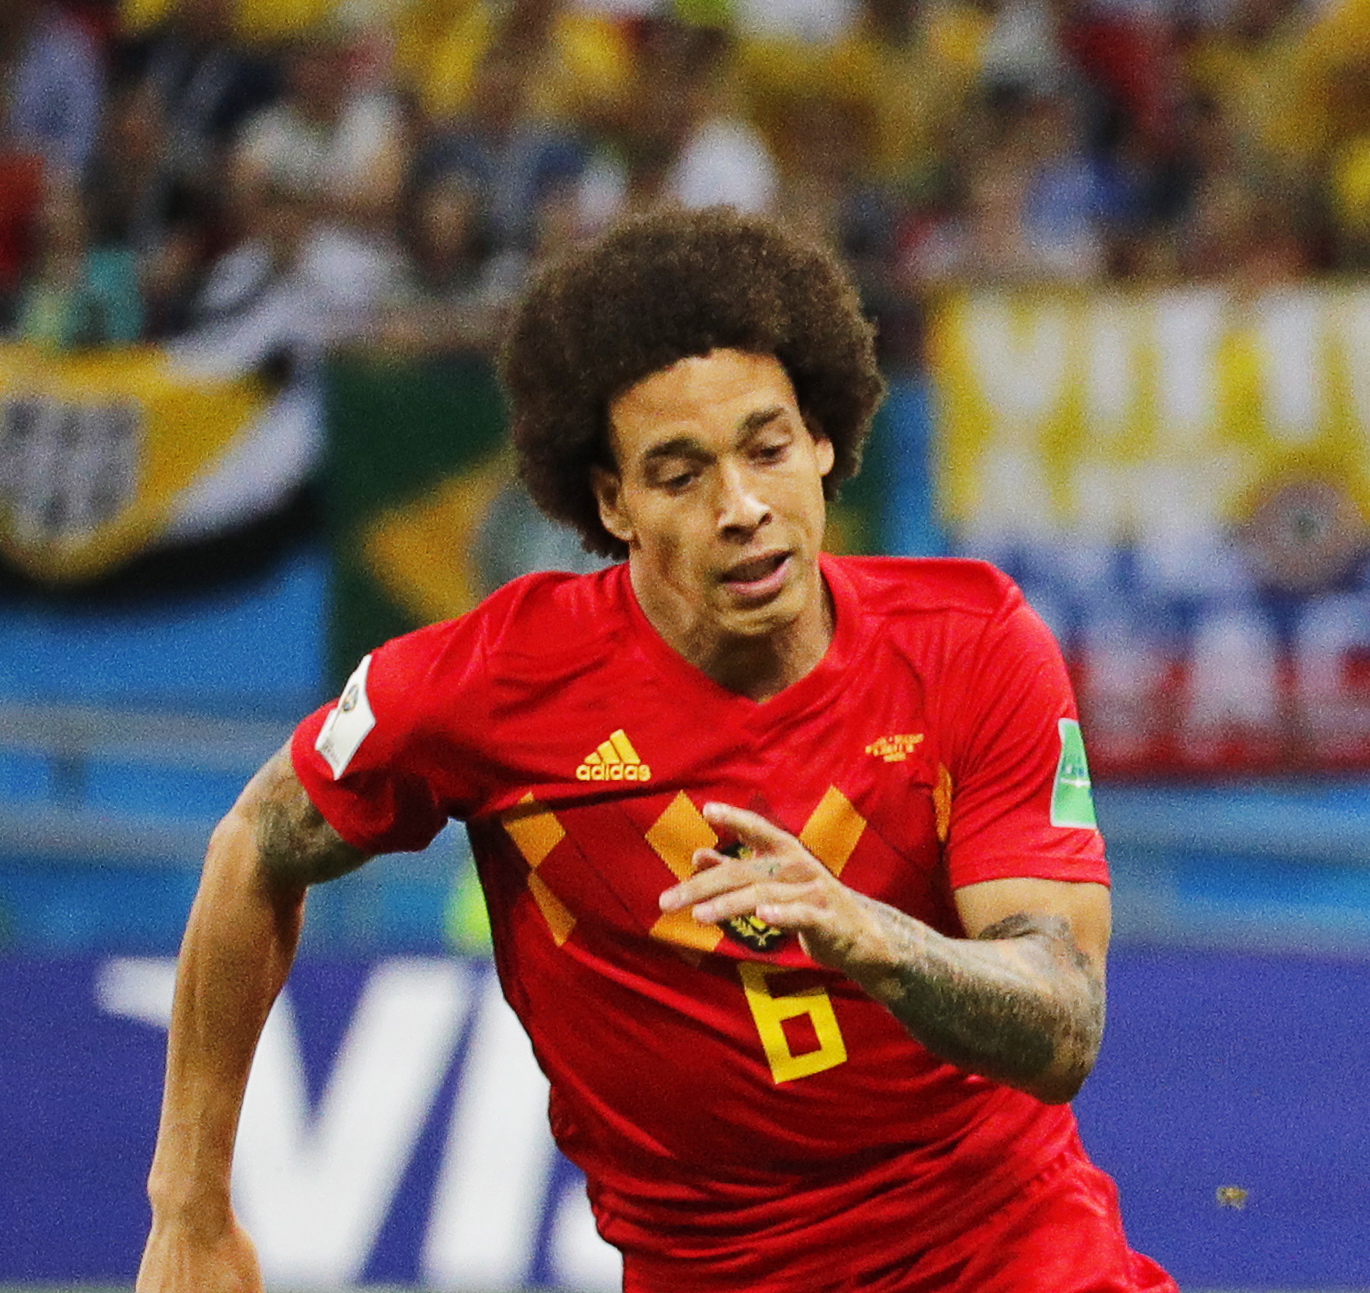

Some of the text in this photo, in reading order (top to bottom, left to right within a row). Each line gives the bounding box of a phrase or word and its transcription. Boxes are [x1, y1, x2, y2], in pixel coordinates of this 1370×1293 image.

[575, 762, 652, 782] adidas
[742, 962, 848, 1085] 6
[95, 957, 625, 1293] VI
